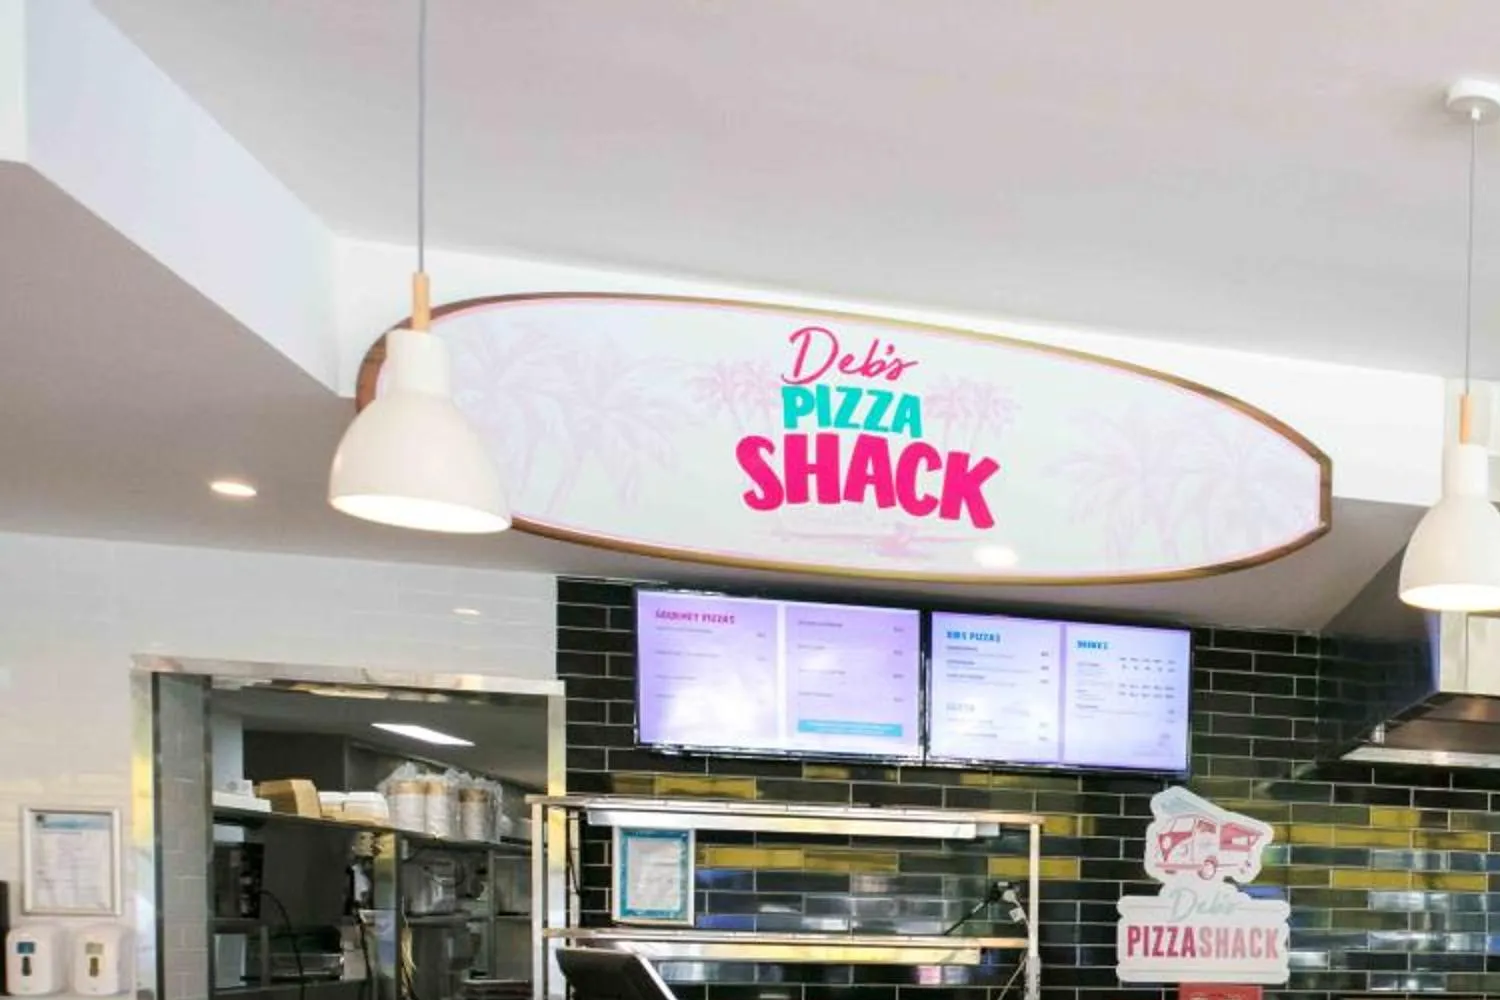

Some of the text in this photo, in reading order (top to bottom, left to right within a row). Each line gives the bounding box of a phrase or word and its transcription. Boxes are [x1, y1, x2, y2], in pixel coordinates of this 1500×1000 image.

[781, 326, 918, 386] Deb's
[781, 384, 922, 439] PIZZA
[736, 432, 1000, 529] SHACK
